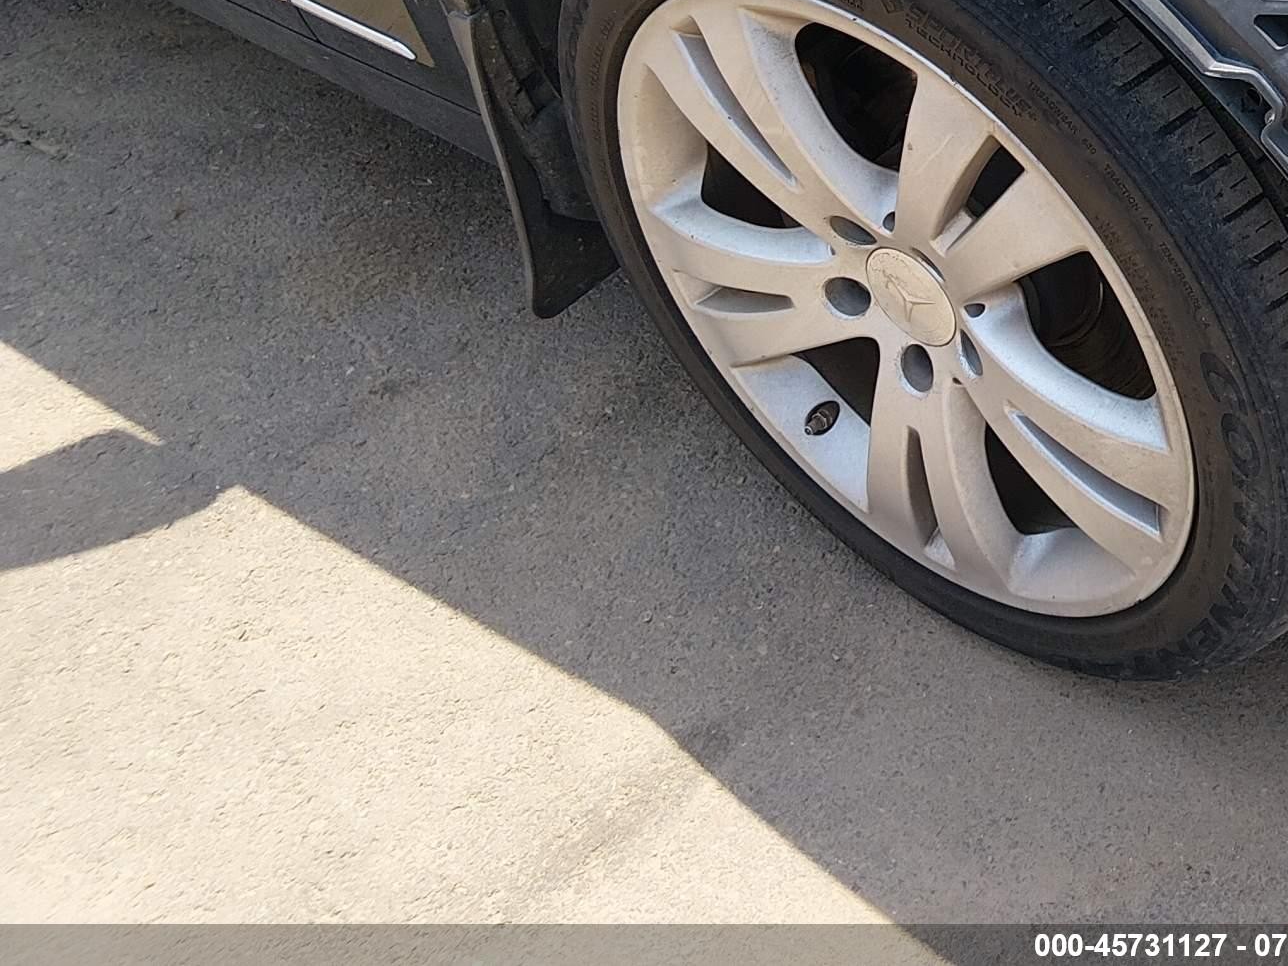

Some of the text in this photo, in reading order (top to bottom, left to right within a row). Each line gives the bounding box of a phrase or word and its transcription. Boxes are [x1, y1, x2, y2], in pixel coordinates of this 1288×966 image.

[904, 16, 1022, 118] TECHNOLOGY
[1104, 163, 1142, 212] TRACTION
[1141, 215, 1154, 231] AA
[1159, 240, 1203, 313] TEMPERATURE
